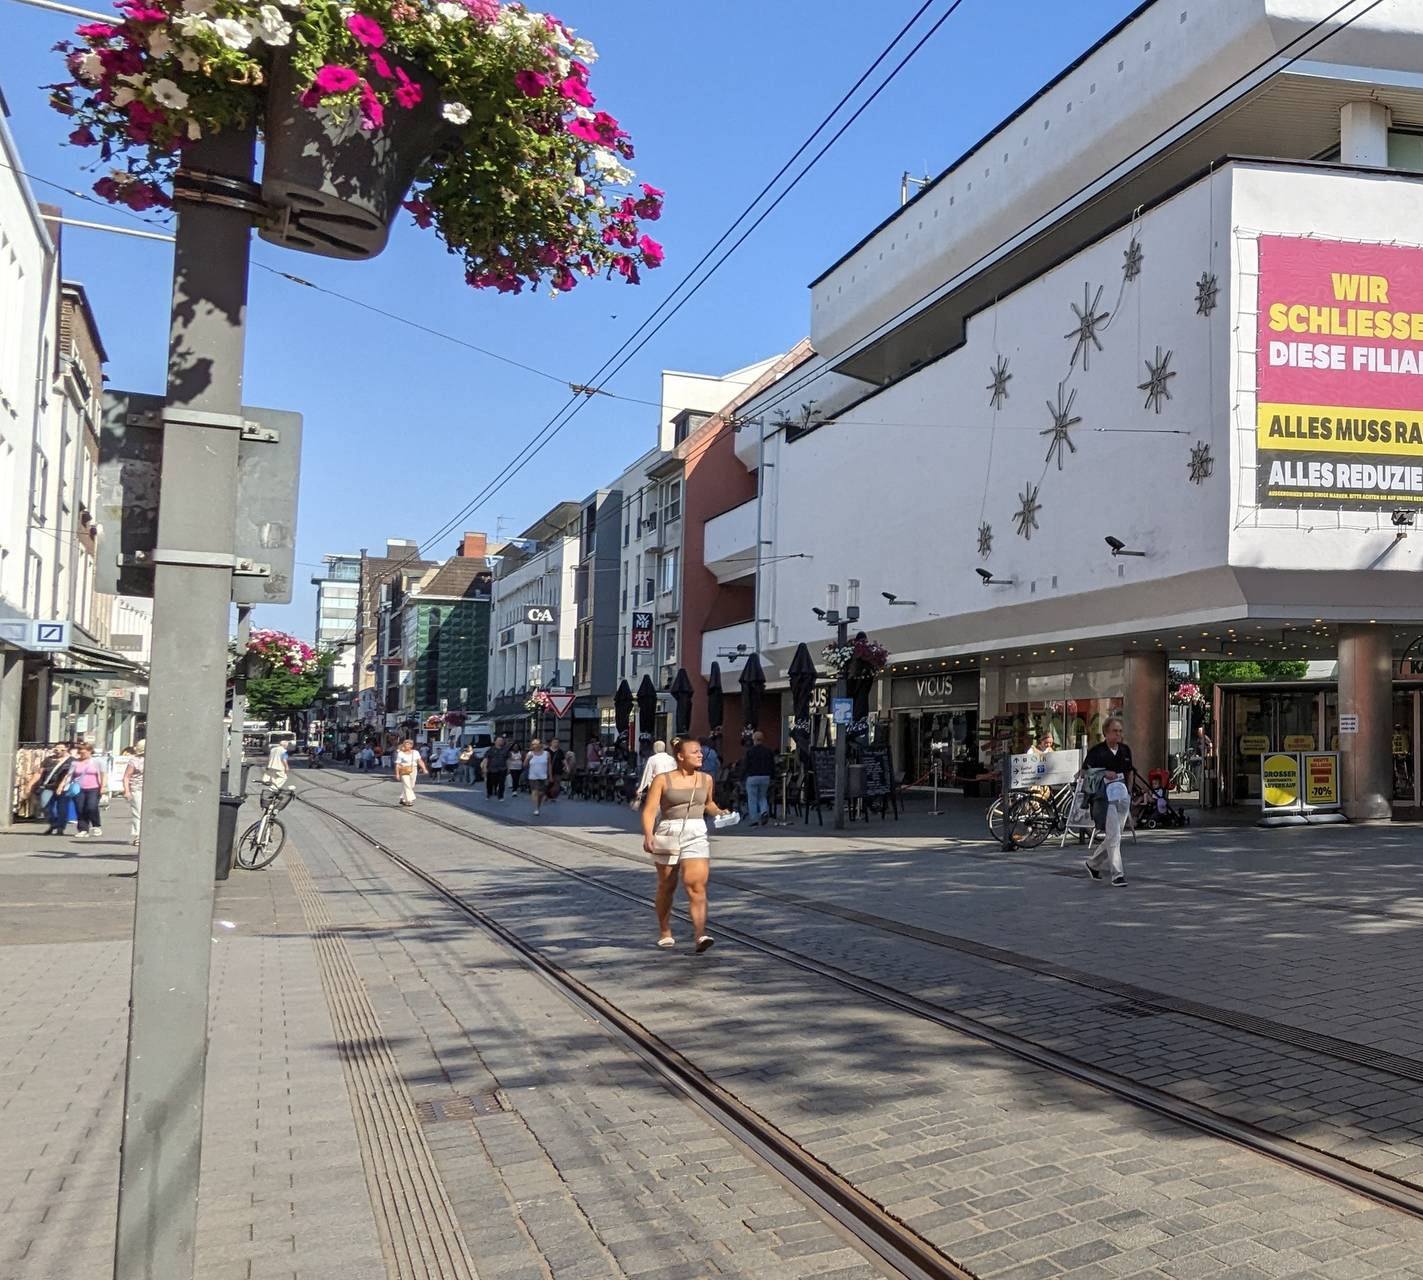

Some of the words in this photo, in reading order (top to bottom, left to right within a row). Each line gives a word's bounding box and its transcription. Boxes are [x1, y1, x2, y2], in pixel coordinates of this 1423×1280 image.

[1331, 273, 1389, 304] WIR
[1269, 342, 1346, 370] DIESE
[1268, 415, 1332, 440] ALLES
[1336, 419, 1392, 443] MUSS
[1268, 460, 1334, 488] ALLES
[528, 609, 554, 622] C&A
[916, 675, 953, 697] VICUS
[1311, 786, 1332, 796] -70%
